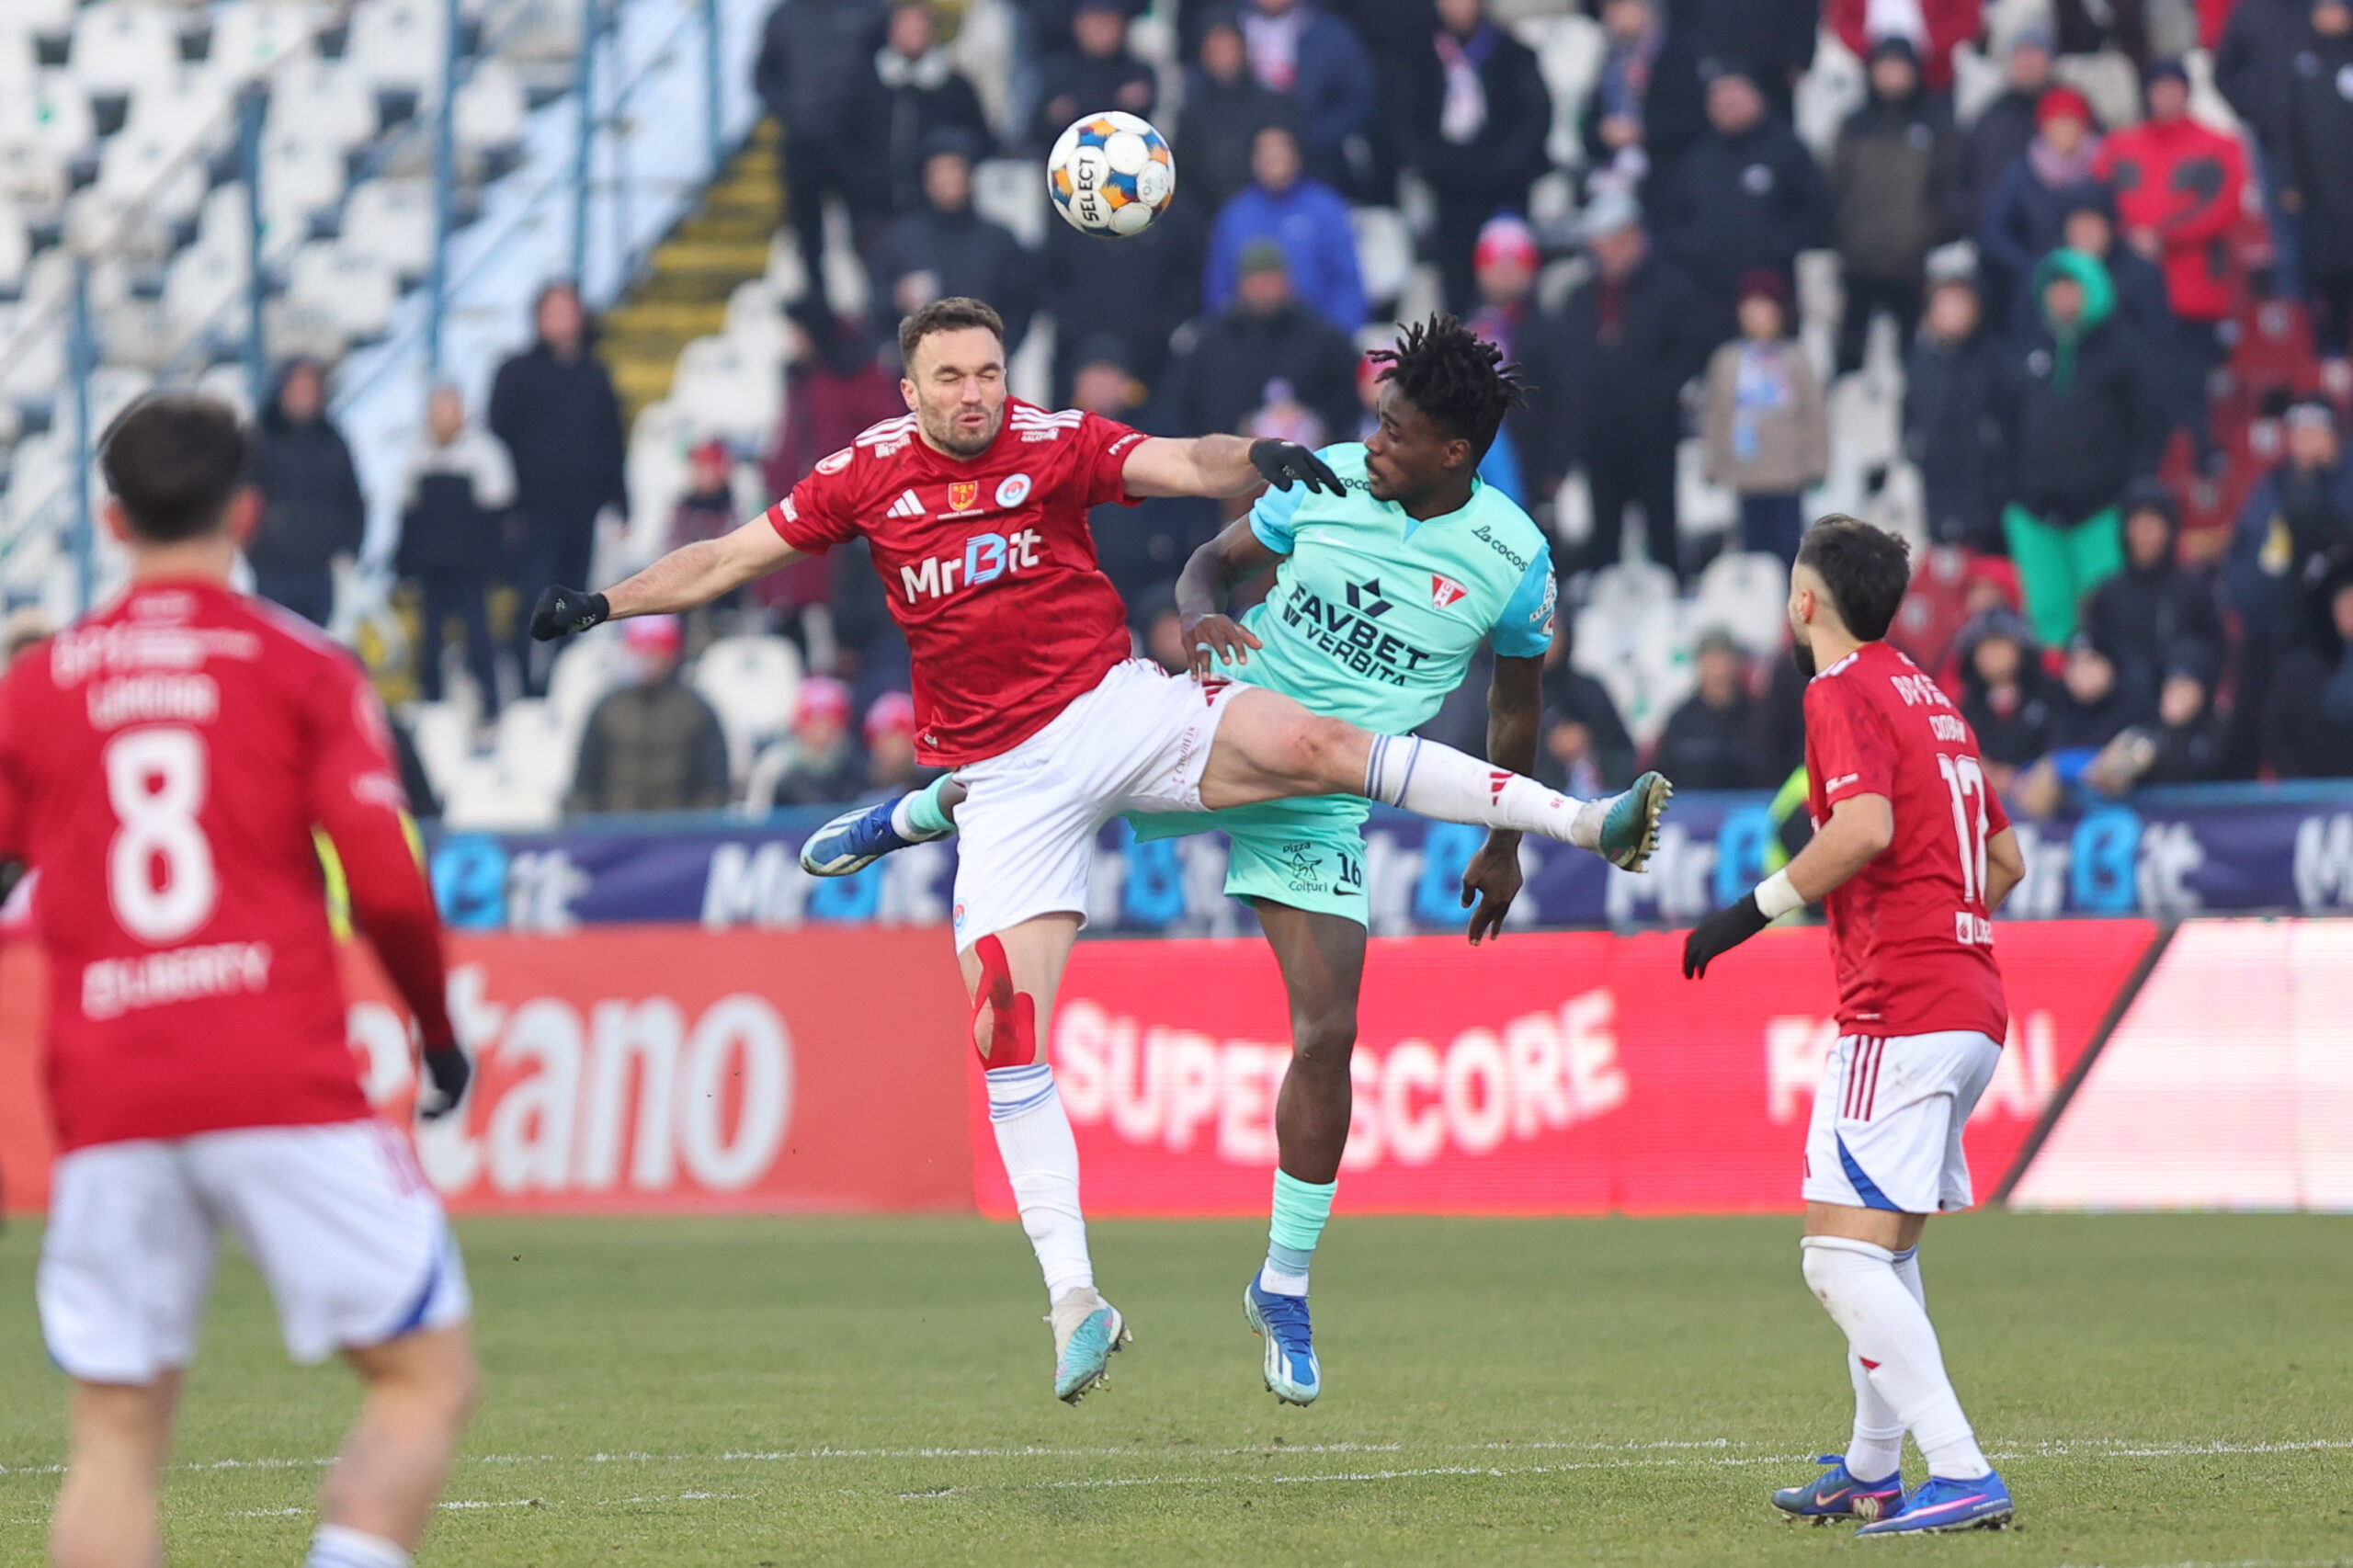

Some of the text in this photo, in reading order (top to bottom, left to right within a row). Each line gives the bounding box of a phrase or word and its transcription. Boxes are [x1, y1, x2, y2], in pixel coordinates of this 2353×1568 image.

[1078, 157, 1100, 222] SELECT
[900, 528, 1042, 604] MrBit
[1472, 525, 1529, 574] La cocos
[1289, 583, 1431, 670] FAVBET
[1306, 622, 1406, 687] VERBITA
[106, 726, 218, 942] 8
[1336, 852, 1362, 889] 16
[1055, 986, 1629, 1170] SUPESCORE
